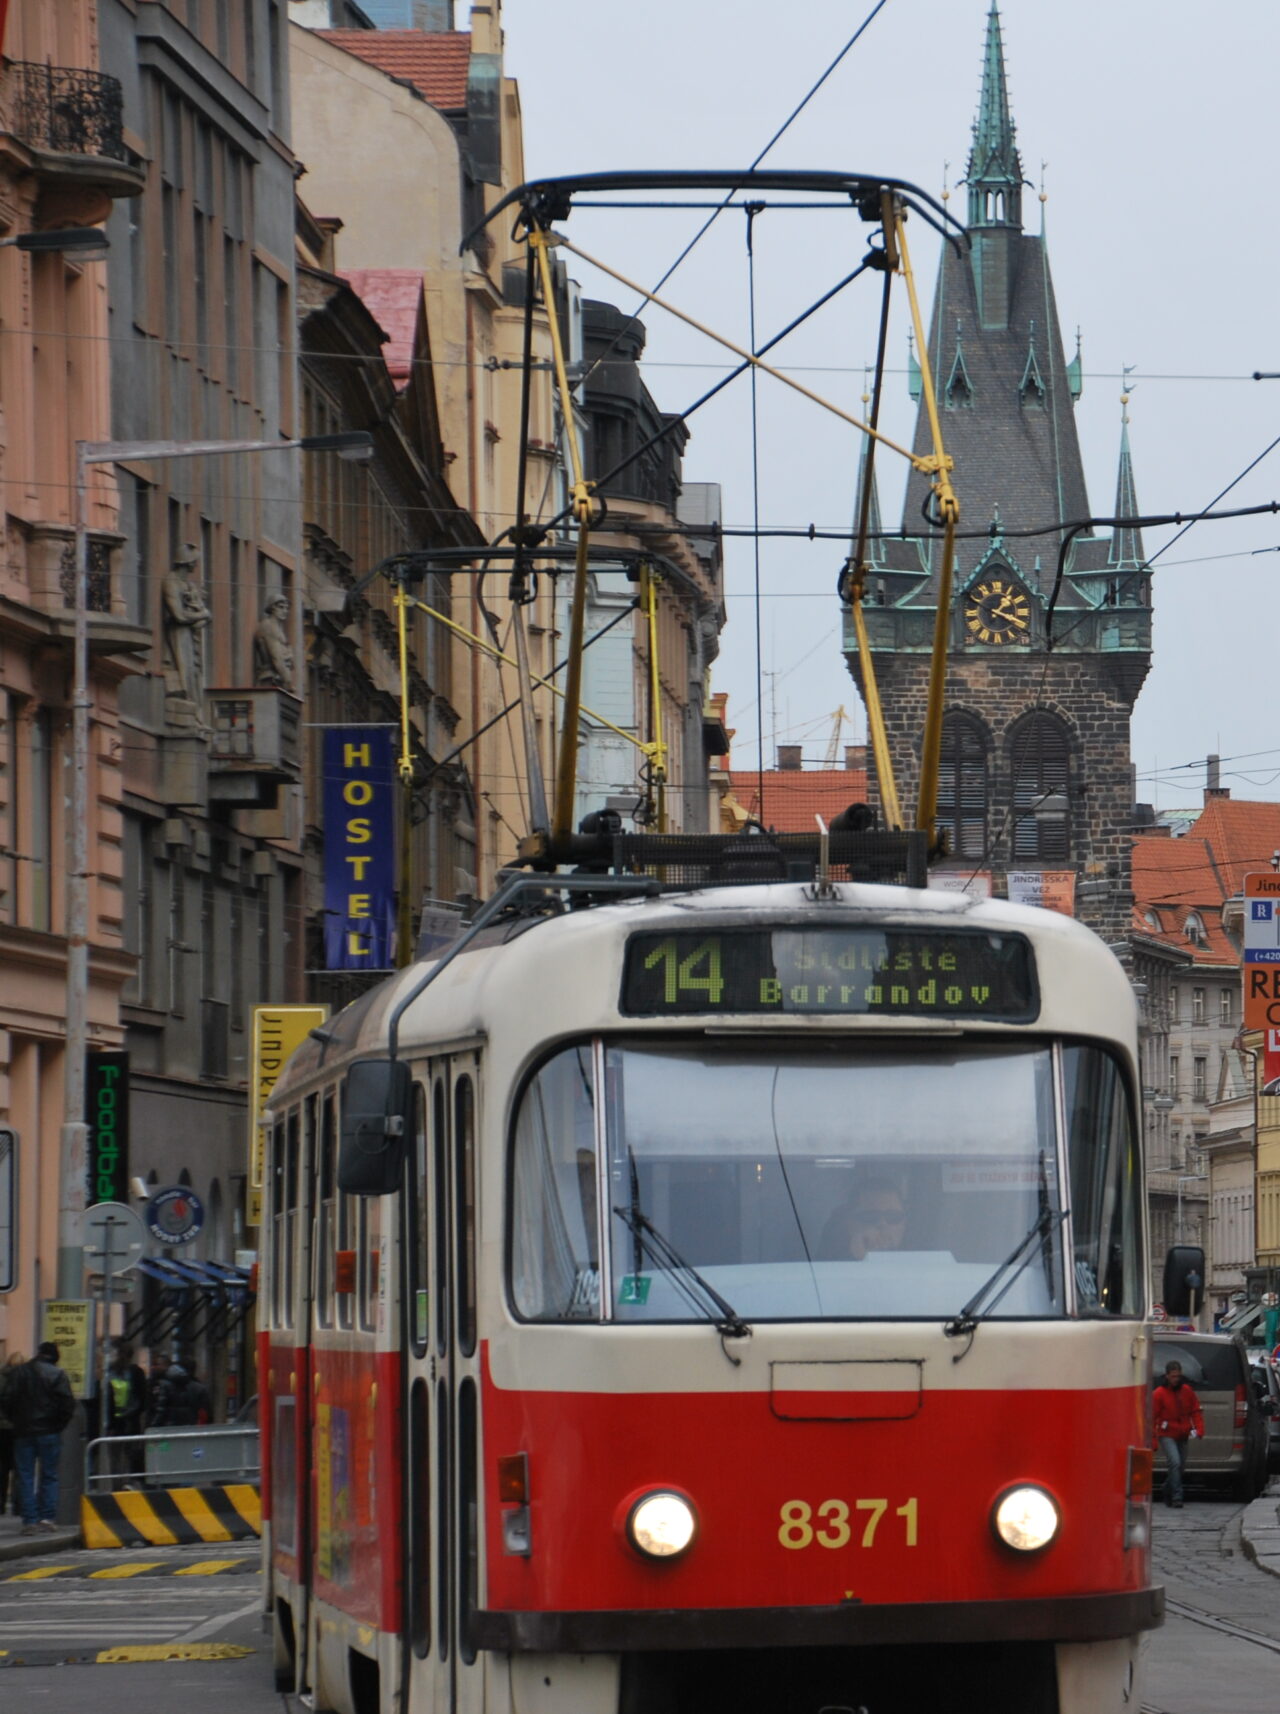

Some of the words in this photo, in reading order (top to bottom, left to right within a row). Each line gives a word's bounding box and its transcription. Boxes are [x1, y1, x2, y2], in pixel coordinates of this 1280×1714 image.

[343, 743, 373, 956] HOSTEL
[644, 938, 724, 1004] 14
[759, 978, 990, 1004] Barrandov
[777, 1498, 919, 1550] 8371
